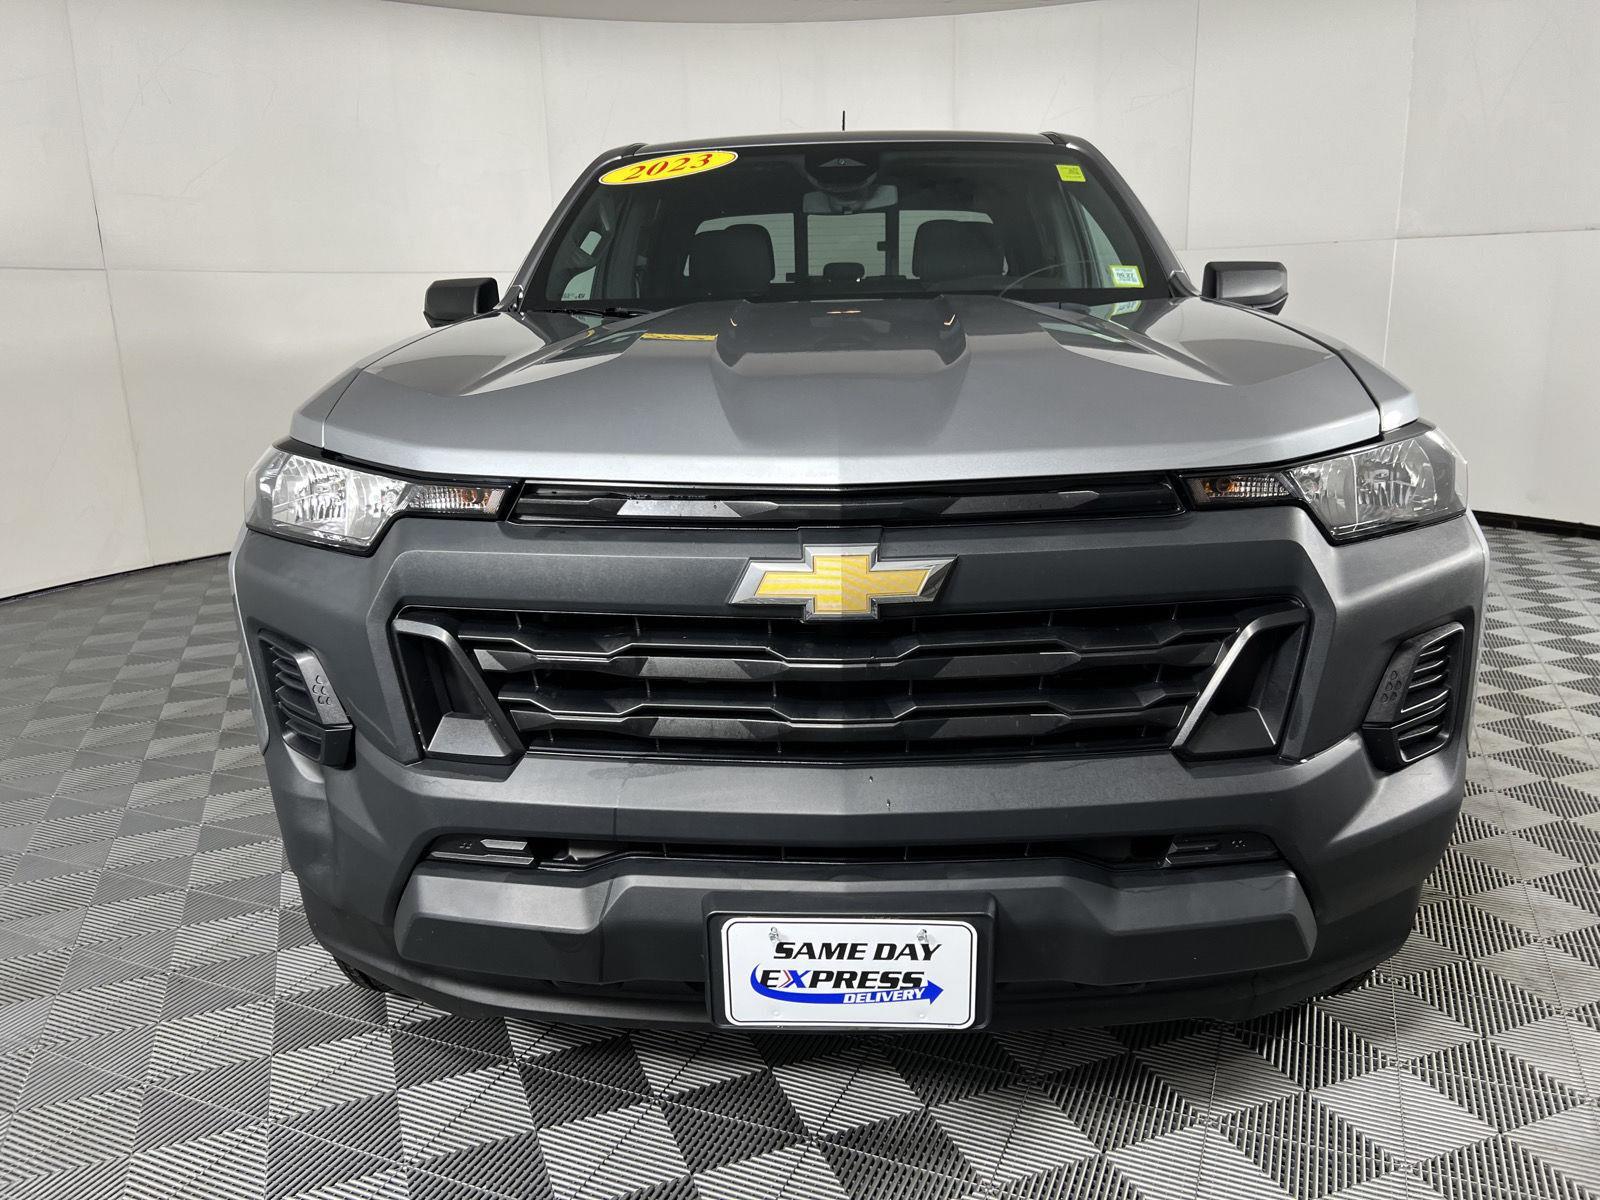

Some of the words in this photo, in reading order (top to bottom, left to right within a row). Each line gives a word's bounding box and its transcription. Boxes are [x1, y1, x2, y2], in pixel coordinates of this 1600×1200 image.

[622, 154, 713, 181] 2023
[773, 942, 869, 960] SAME
[873, 943, 942, 961] DAY
[760, 969, 925, 989] EXPRESS
[843, 988, 926, 1004] DELIVERY
